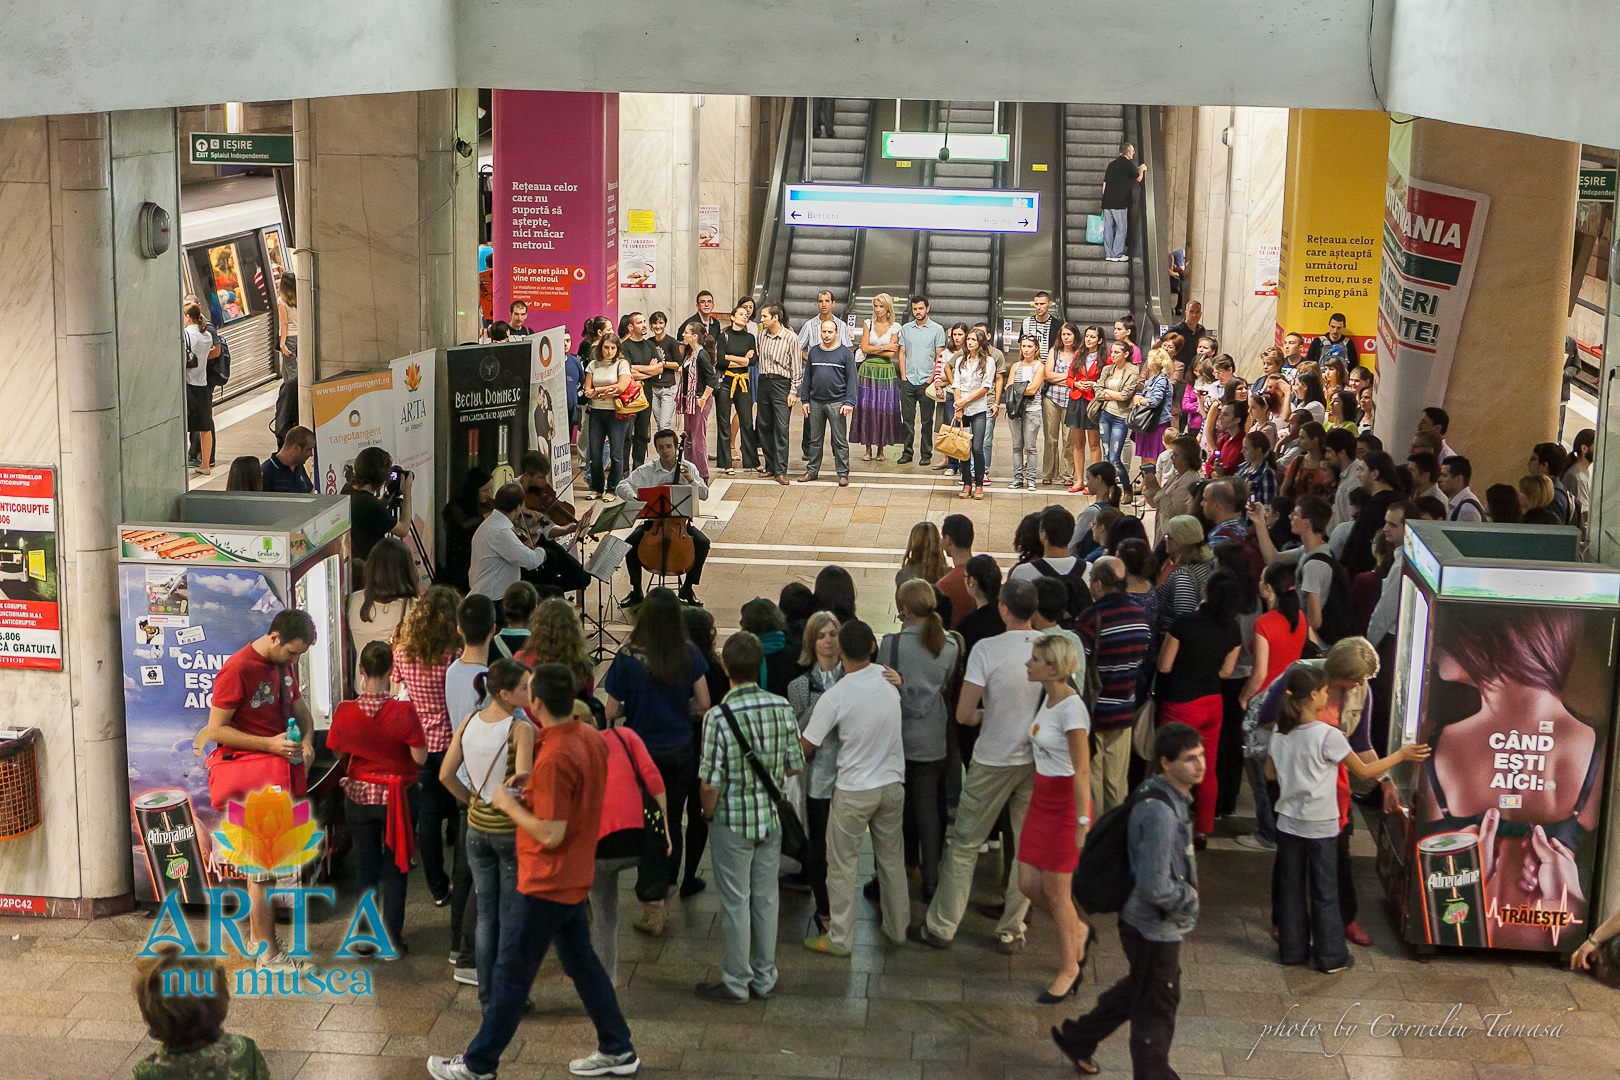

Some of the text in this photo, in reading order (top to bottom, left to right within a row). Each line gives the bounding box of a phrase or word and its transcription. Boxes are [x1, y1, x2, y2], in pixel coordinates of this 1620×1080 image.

[223, 140, 253, 151] IEȘIRE
[512, 182, 578, 193] Rețeaua celor
[512, 195, 549, 203] care nu
[512, 206, 563, 216] suportă să
[512, 218, 551, 228] aștepte,
[512, 229, 565, 239] nici măcar
[512, 241, 555, 250] metroul.
[1306, 235, 1375, 246] Rețeaua celor
[1305, 249, 1372, 259] care așteaptă
[513, 266, 527, 274] Stai
[528, 268, 537, 276] pe
[551, 267, 569, 276] până
[1305, 261, 1358, 271] următorul
[529, 275, 559, 283] metroul
[1304, 275, 1344, 284] metrou,
[1303, 286, 1369, 298] împing până
[1302, 300, 1334, 311] încap.
[534, 362, 562, 381] tangotangent
[315, 377, 390, 396] www.tangotangent.ro
[400, 398, 427, 426] ARTA
[329, 427, 382, 444] tangotangent
[1488, 729, 1555, 752] CÂND
[1489, 772, 1544, 791] AICI:
[146, 825, 195, 849] Adrenaline
[1427, 869, 1480, 893] Adrenaline
